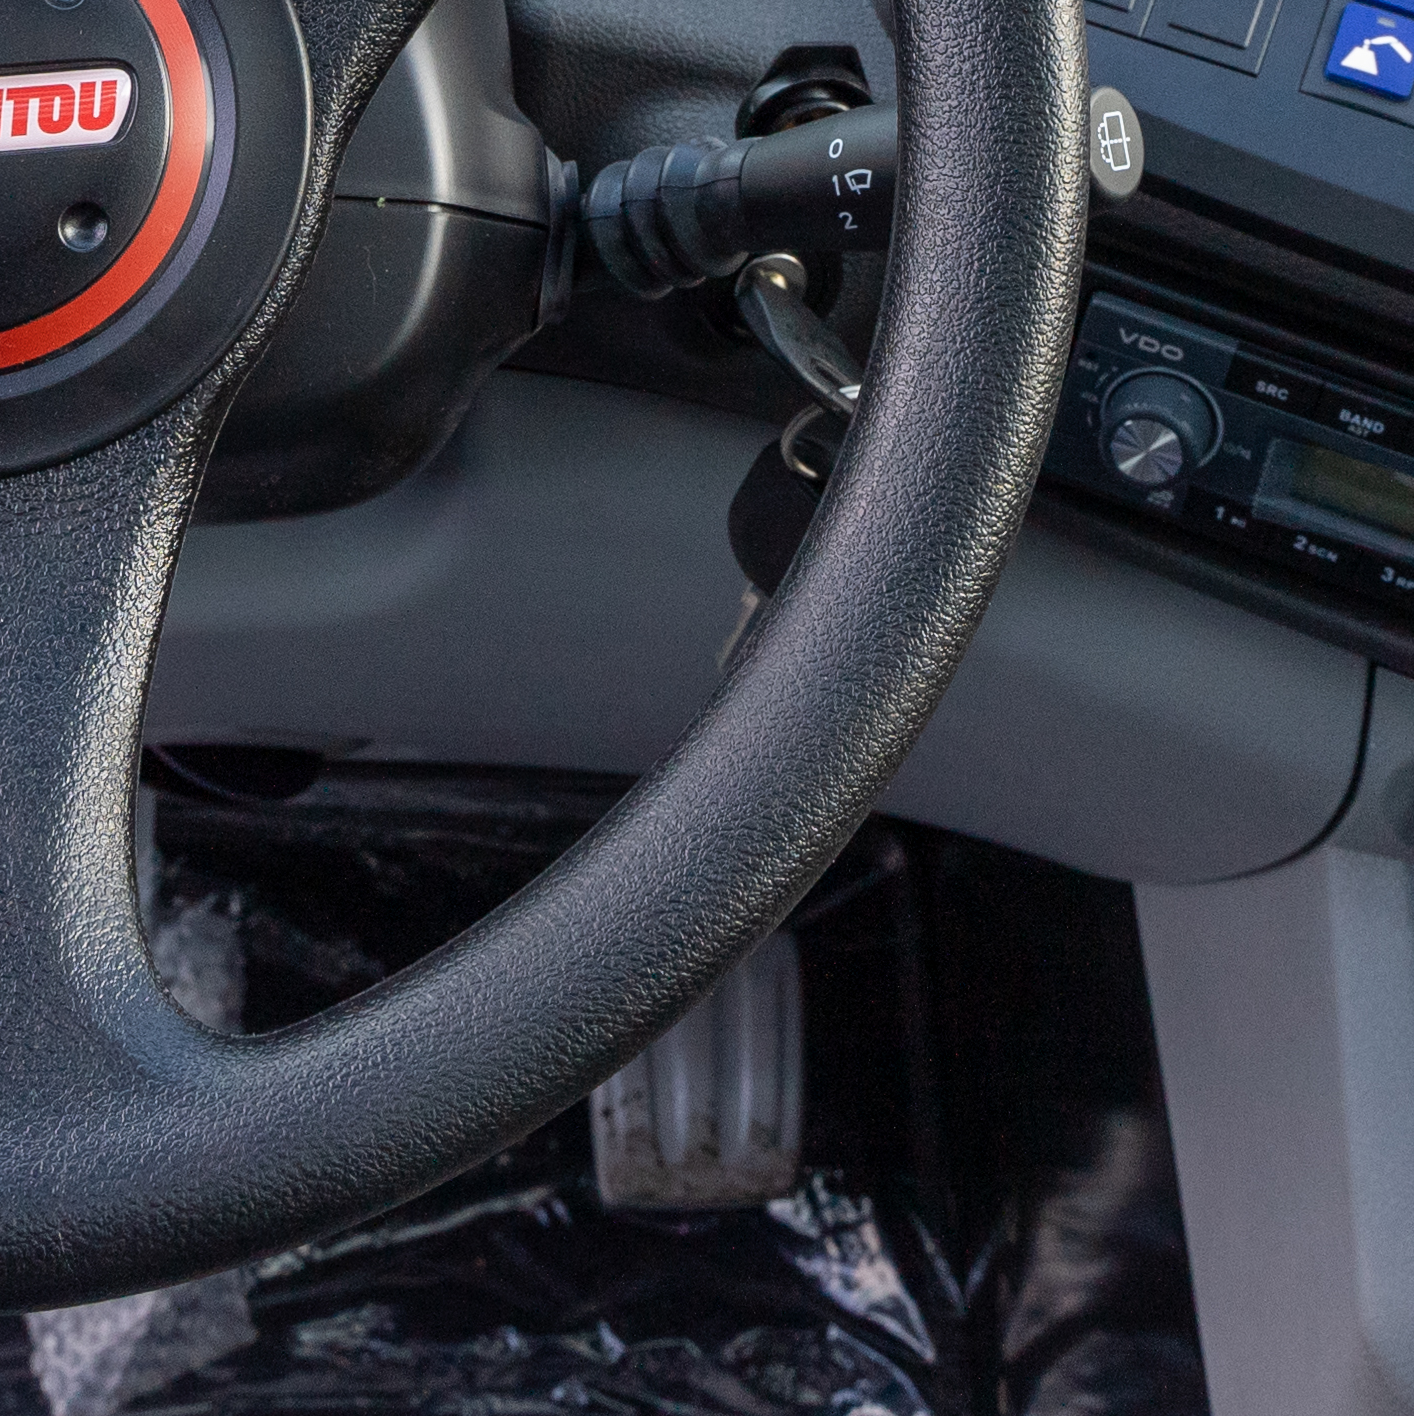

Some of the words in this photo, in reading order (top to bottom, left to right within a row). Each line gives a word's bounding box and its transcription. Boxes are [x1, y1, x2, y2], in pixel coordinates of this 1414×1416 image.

[828, 138, 844, 159] 0
[838, 211, 858, 230] 2
[1118, 327, 1185, 362] VDO
[1254, 380, 1289, 401] SRC
[1339, 408, 1385, 434] BAND
[1215, 506, 1225, 521] 1
